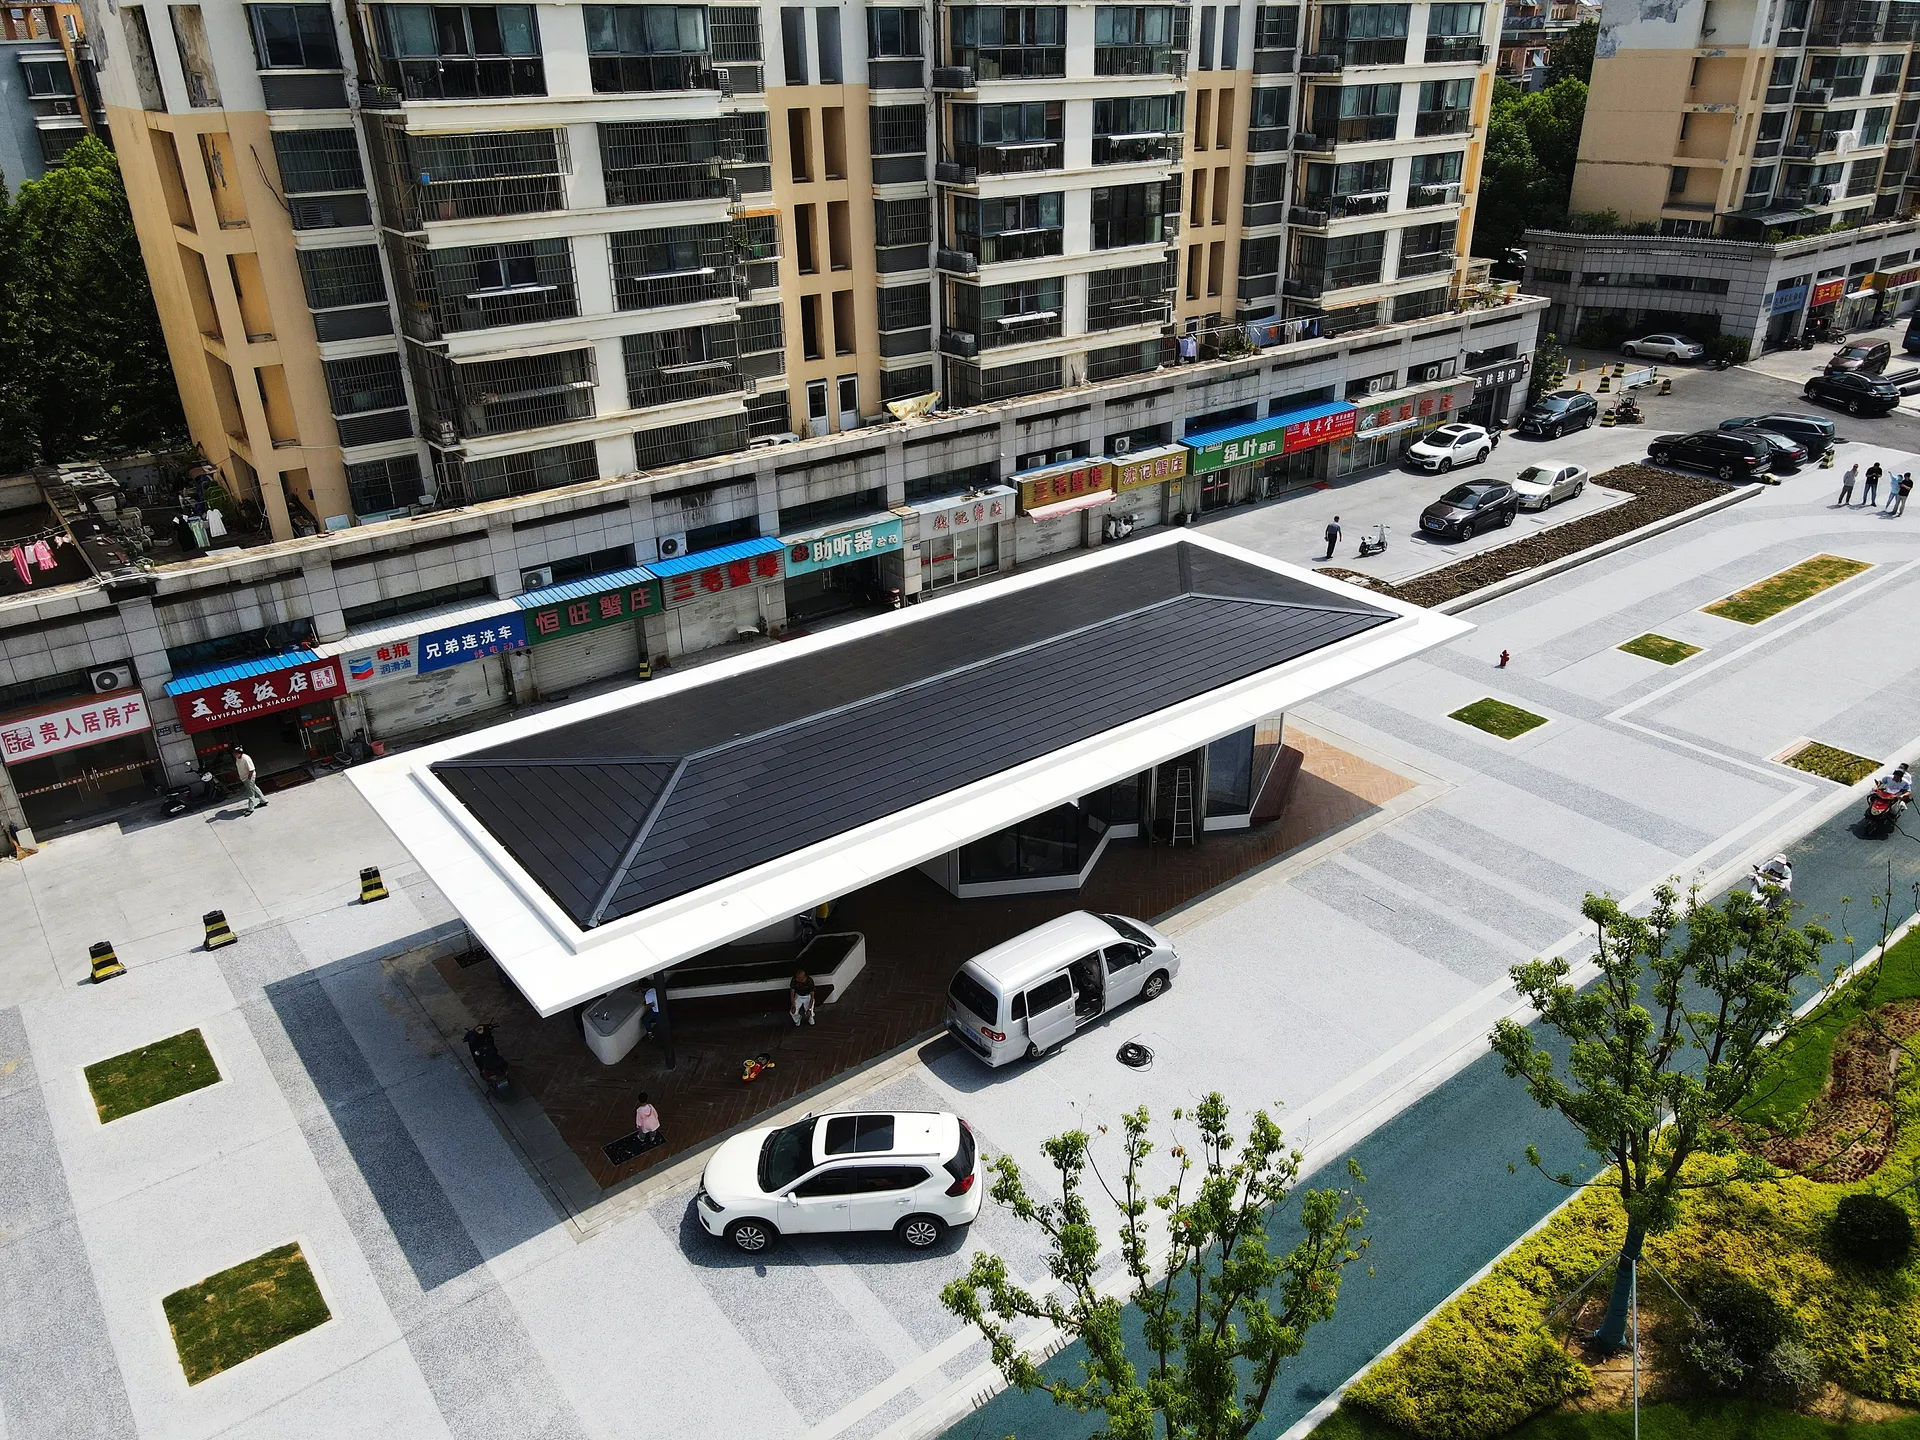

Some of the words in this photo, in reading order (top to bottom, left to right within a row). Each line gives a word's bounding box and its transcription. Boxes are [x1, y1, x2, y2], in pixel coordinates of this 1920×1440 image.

[1123, 456, 1184, 485] 沈记蟹庄
[813, 529, 873, 562] 助听器
[536, 587, 653, 636] 恒旺蟹庄
[376, 641, 411, 662] 电瓶
[425, 625, 513, 660] 兄弟连洗车
[380, 659, 412, 675] 润滑油
[191, 672, 309, 719] 玉意饭店
[205, 703, 263, 723] YUYIFANDIAN
[266, 694, 300, 707] XIAOCHI
[39, 702, 140, 745] 贵人居房产
